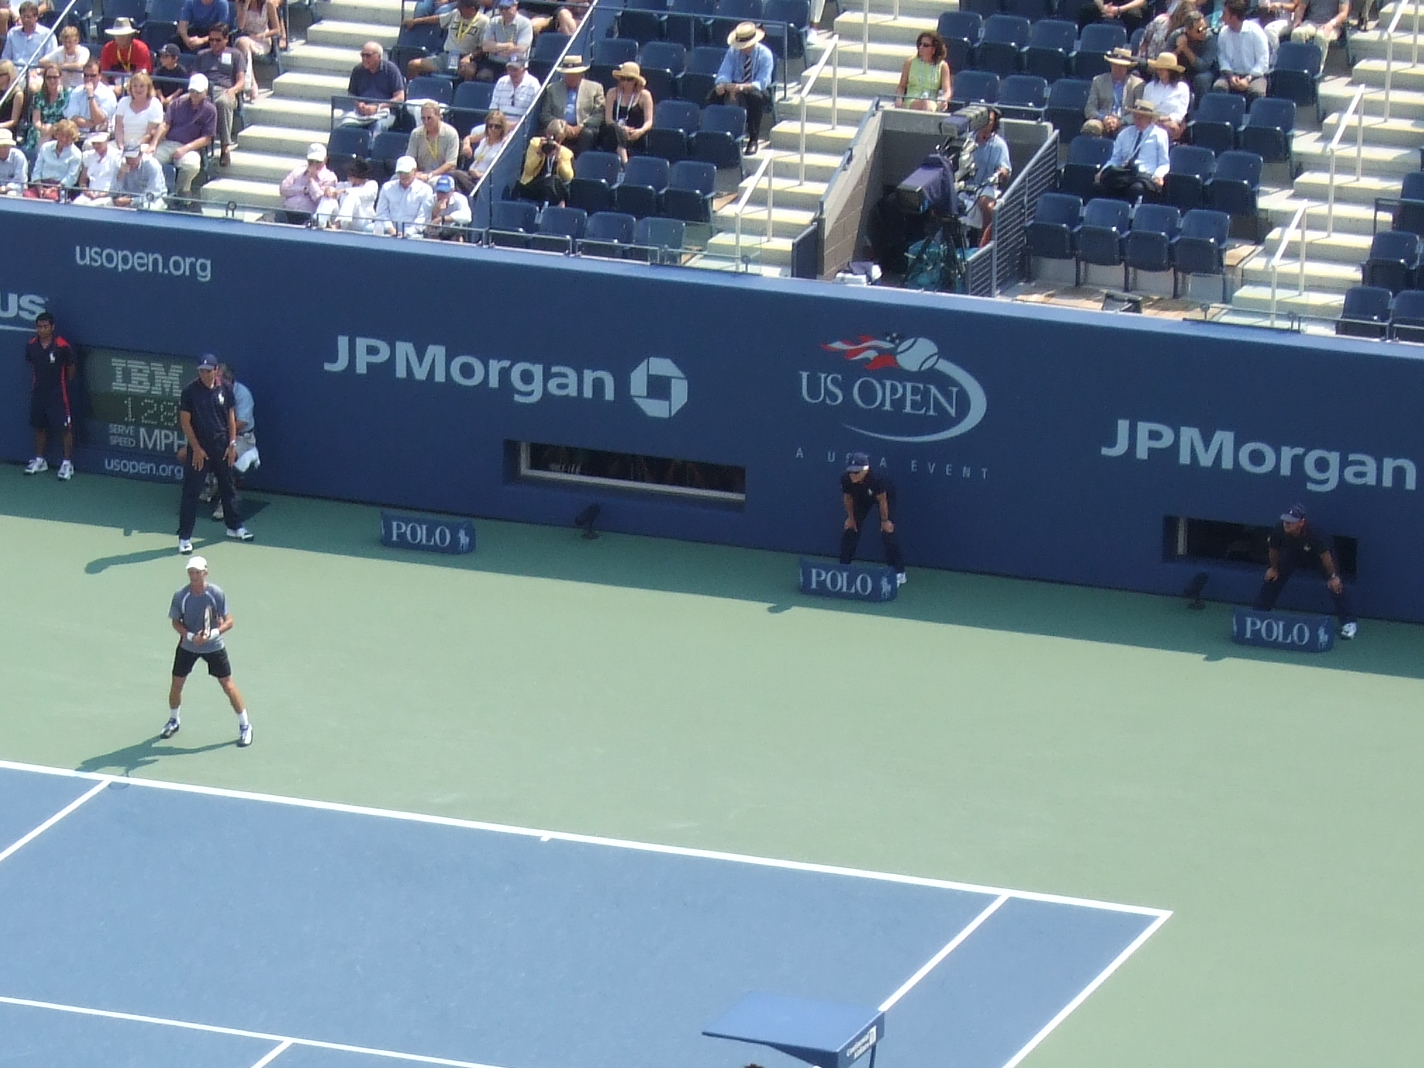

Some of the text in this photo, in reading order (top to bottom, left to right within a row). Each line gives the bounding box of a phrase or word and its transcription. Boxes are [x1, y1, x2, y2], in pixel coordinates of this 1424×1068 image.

[75, 245, 212, 282] usopen.org
[111, 358, 184, 397] IBM
[323, 335, 615, 404] JPMorgan
[799, 371, 960, 418] US OPEN
[109, 423, 135, 436] SERVE
[109, 435, 136, 448] SPEED
[139, 427, 188, 453] MPH
[104, 456, 185, 480] usopen.org
[795, 447, 804, 459] A
[911, 459, 989, 480] EVENT
[1100, 419, 1417, 492] JPMorgan
[391, 520, 451, 549] POLO
[809, 567, 873, 597] POLO
[1243, 616, 1310, 647] POLO
